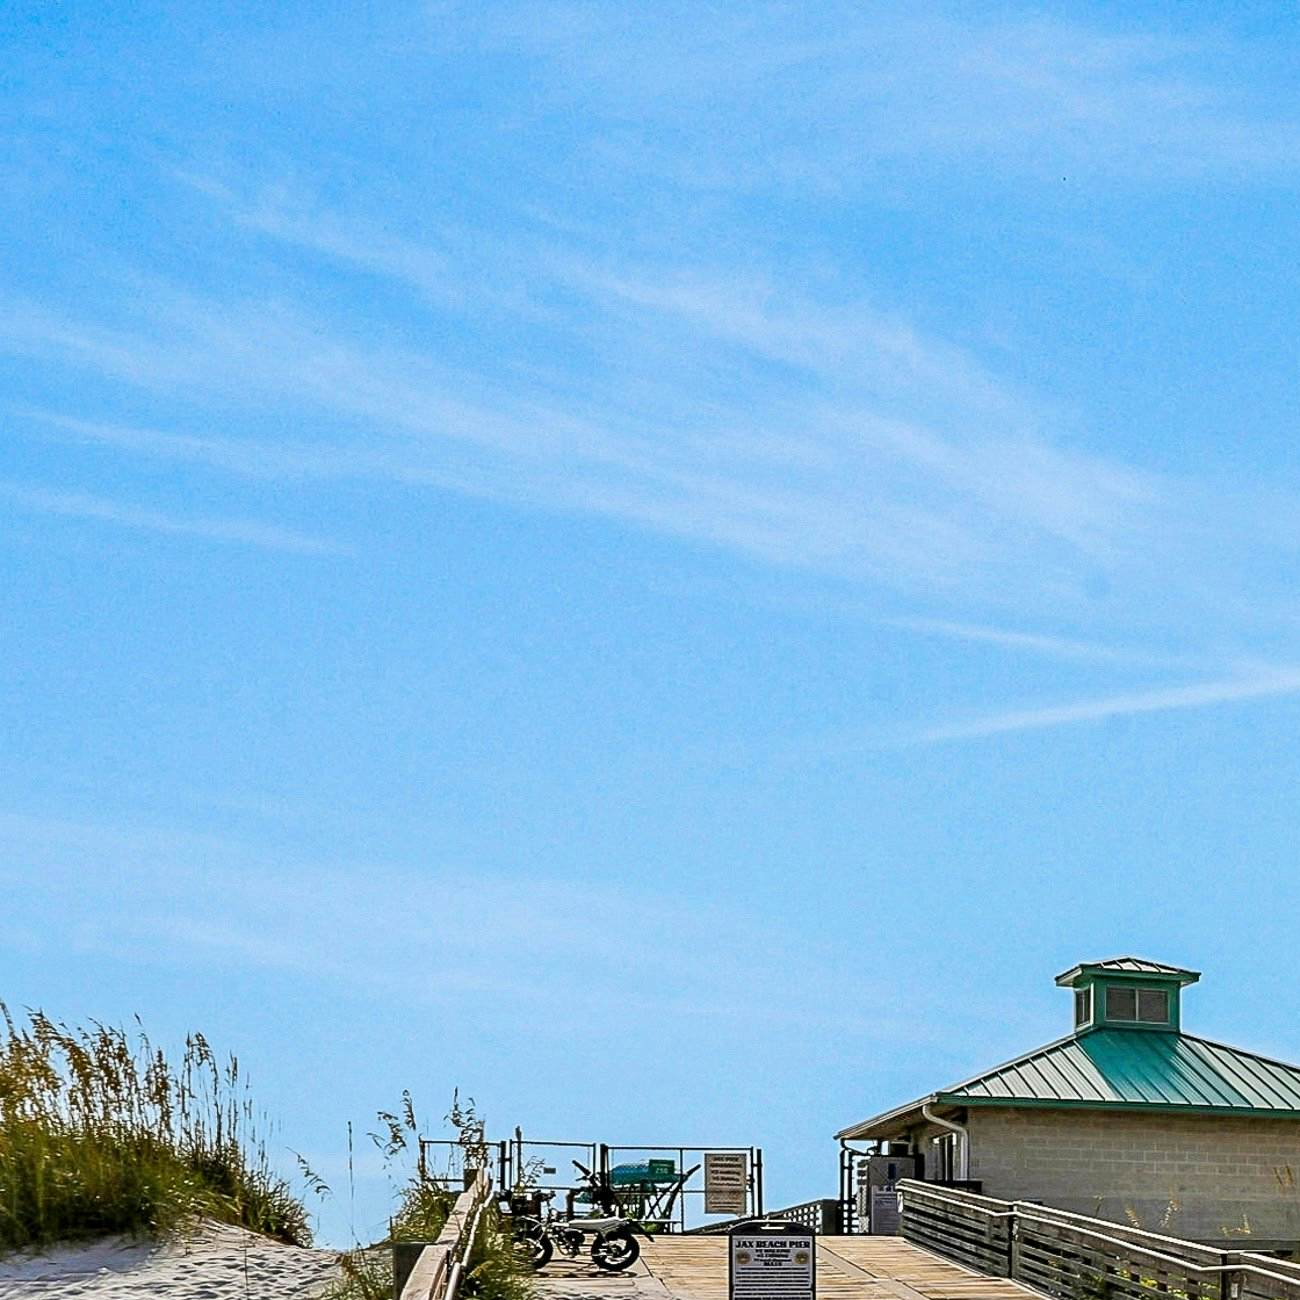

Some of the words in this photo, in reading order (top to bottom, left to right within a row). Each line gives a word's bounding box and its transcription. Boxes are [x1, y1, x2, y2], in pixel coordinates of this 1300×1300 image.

[735, 1240, 754, 1248] JAX
[756, 1240, 787, 1248] BEACH
[788, 1240, 811, 1248] PIER
